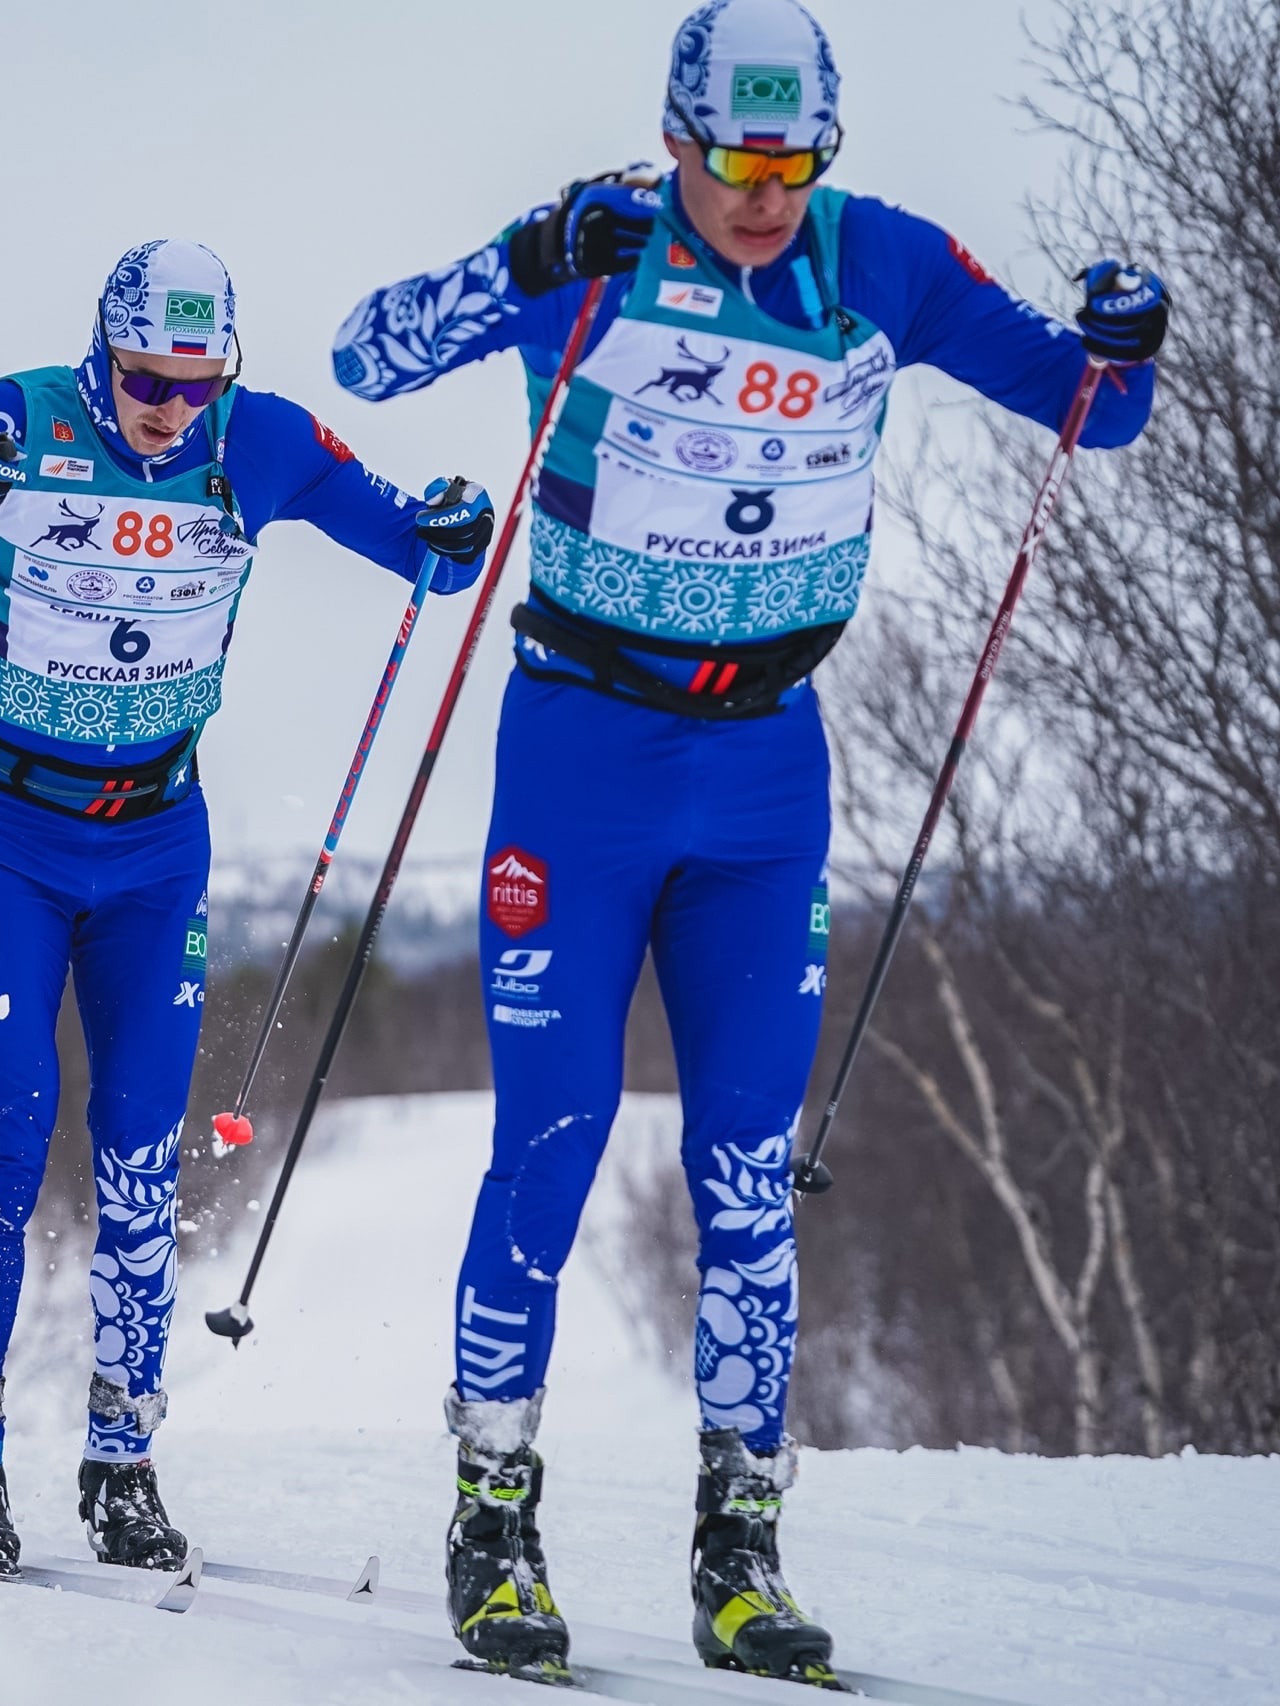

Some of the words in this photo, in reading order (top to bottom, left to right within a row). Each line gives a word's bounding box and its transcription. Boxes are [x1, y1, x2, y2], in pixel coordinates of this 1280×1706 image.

[1102, 286, 1155, 314] COXA
[164, 325, 216, 335] БИОХИММАК
[738, 361, 819, 419] 88
[428, 508, 471, 528] COXA
[113, 510, 173, 558] 88
[646, 532, 762, 559] РУССКАЯ
[770, 530, 827, 558] ЗИМА
[198, 538, 249, 564] Севера
[109, 619, 151, 664] 6
[47, 659, 140, 683] РУССКАЯ
[144, 657, 194, 681] ЗИМА
[493, 882, 538, 907] rittis
[491, 975, 540, 994] Julbo
